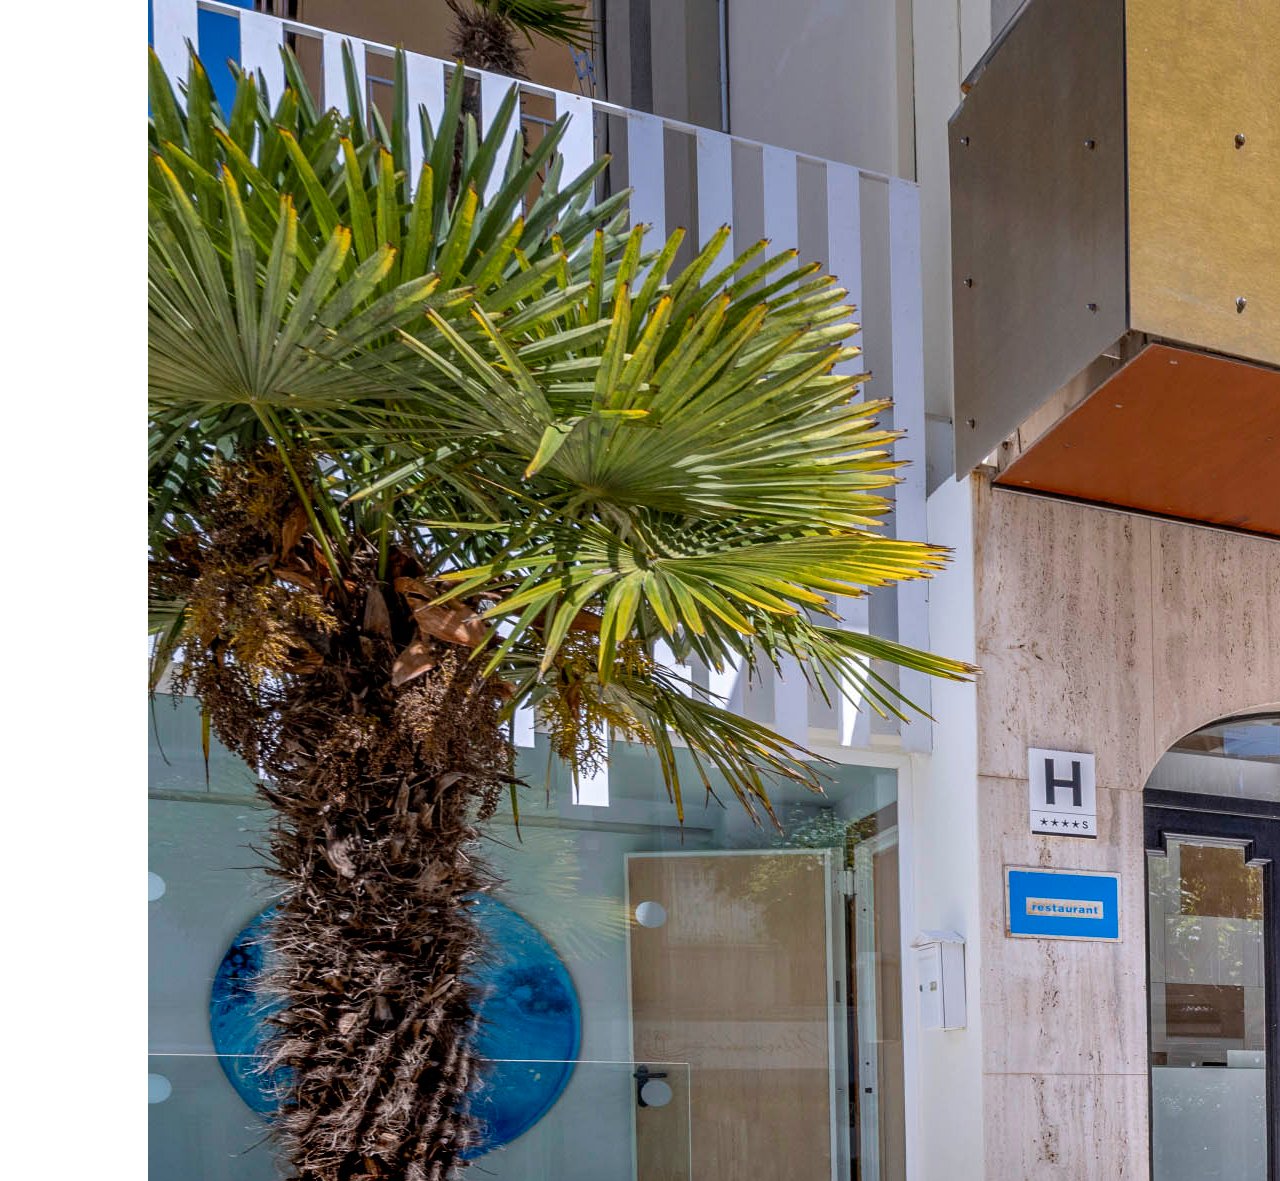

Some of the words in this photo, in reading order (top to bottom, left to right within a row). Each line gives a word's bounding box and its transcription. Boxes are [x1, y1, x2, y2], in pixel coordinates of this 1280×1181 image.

[1044, 758, 1082, 807] H
[1082, 821, 1089, 830] S
[1031, 902, 1099, 915] restaurant
